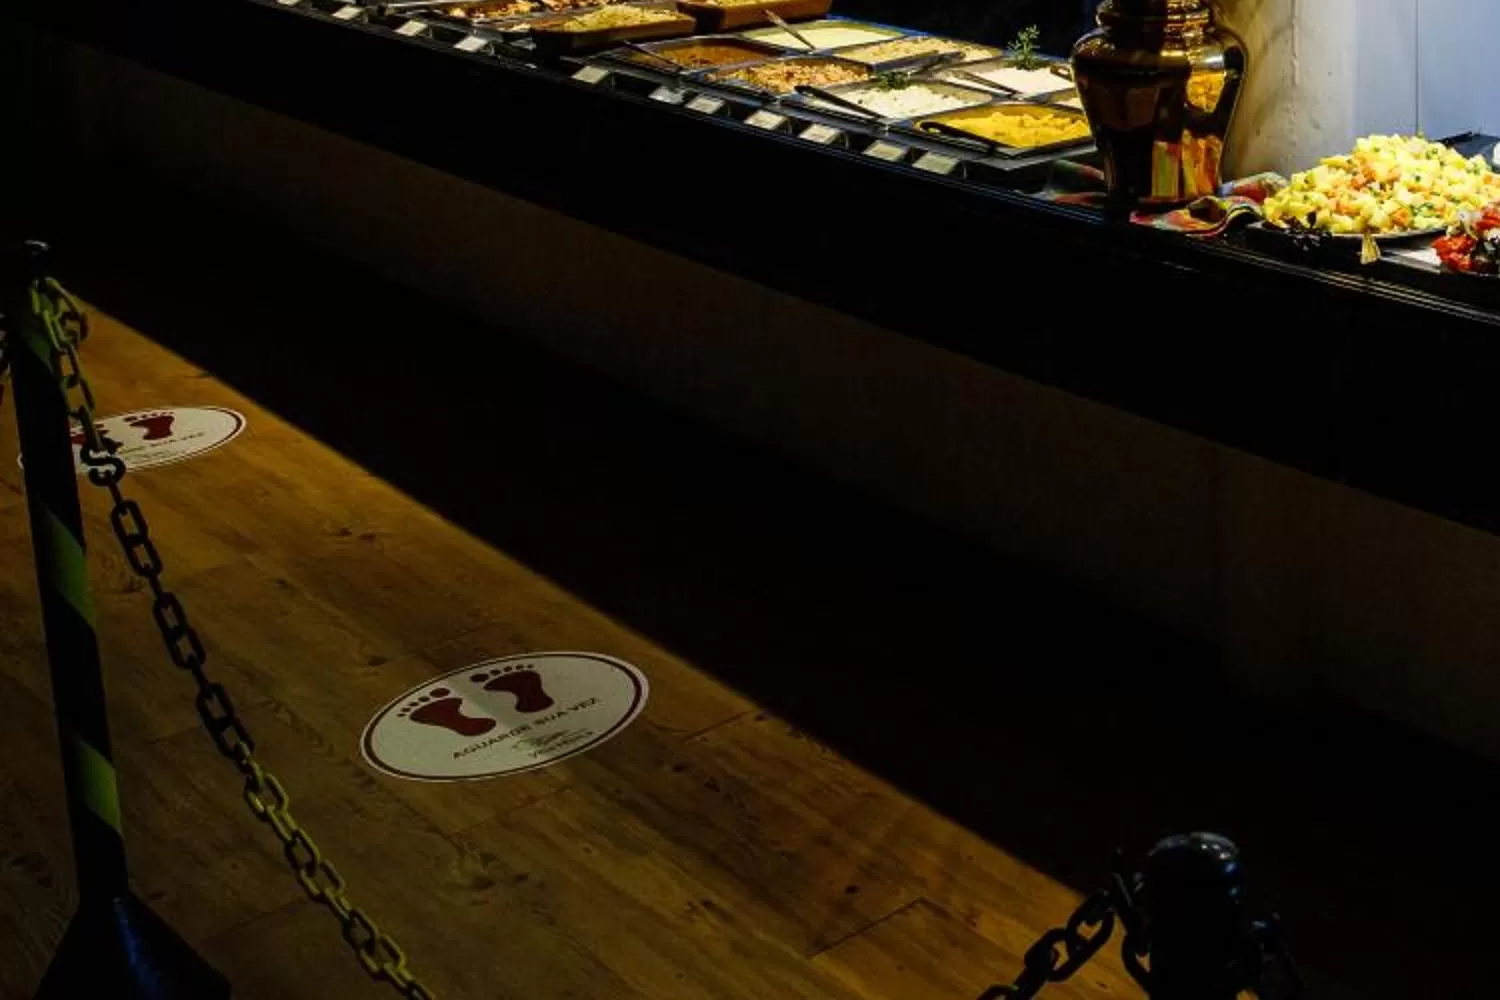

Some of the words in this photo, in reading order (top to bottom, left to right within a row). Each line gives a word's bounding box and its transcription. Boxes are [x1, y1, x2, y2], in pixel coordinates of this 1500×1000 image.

[453, 724, 532, 760] AGUARDE
[532, 711, 568, 725] SUA
[566, 697, 598, 711] VEZ
